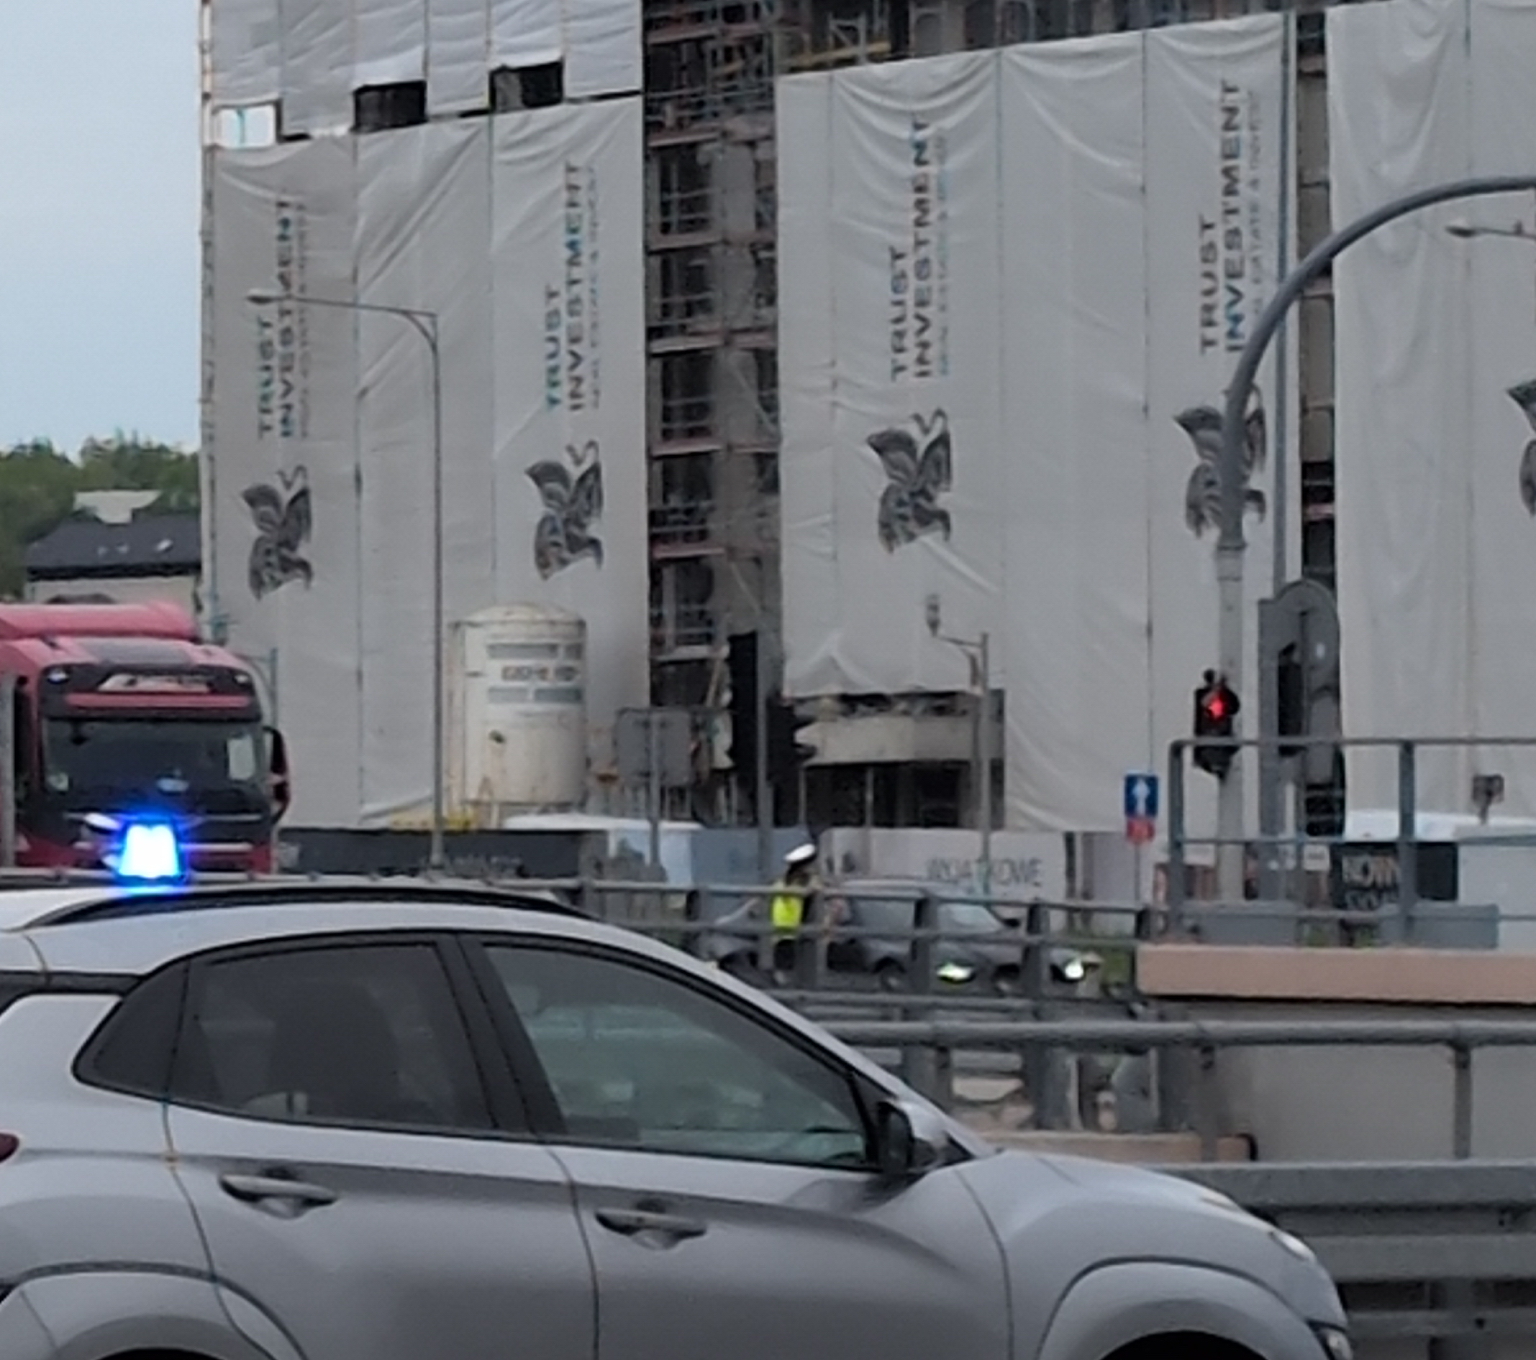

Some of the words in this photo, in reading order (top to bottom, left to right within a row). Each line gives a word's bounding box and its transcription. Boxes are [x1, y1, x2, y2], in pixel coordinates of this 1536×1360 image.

[566, 160, 583, 412] INVESTMENT
[912, 118, 931, 379] INVESTMENT
[1199, 213, 1218, 356] TRUST
[1220, 78, 1245, 354] INVESTMENT
[257, 316, 273, 439] TRUST
[545, 284, 562, 412] TRUST
[889, 245, 908, 383] TRUST
